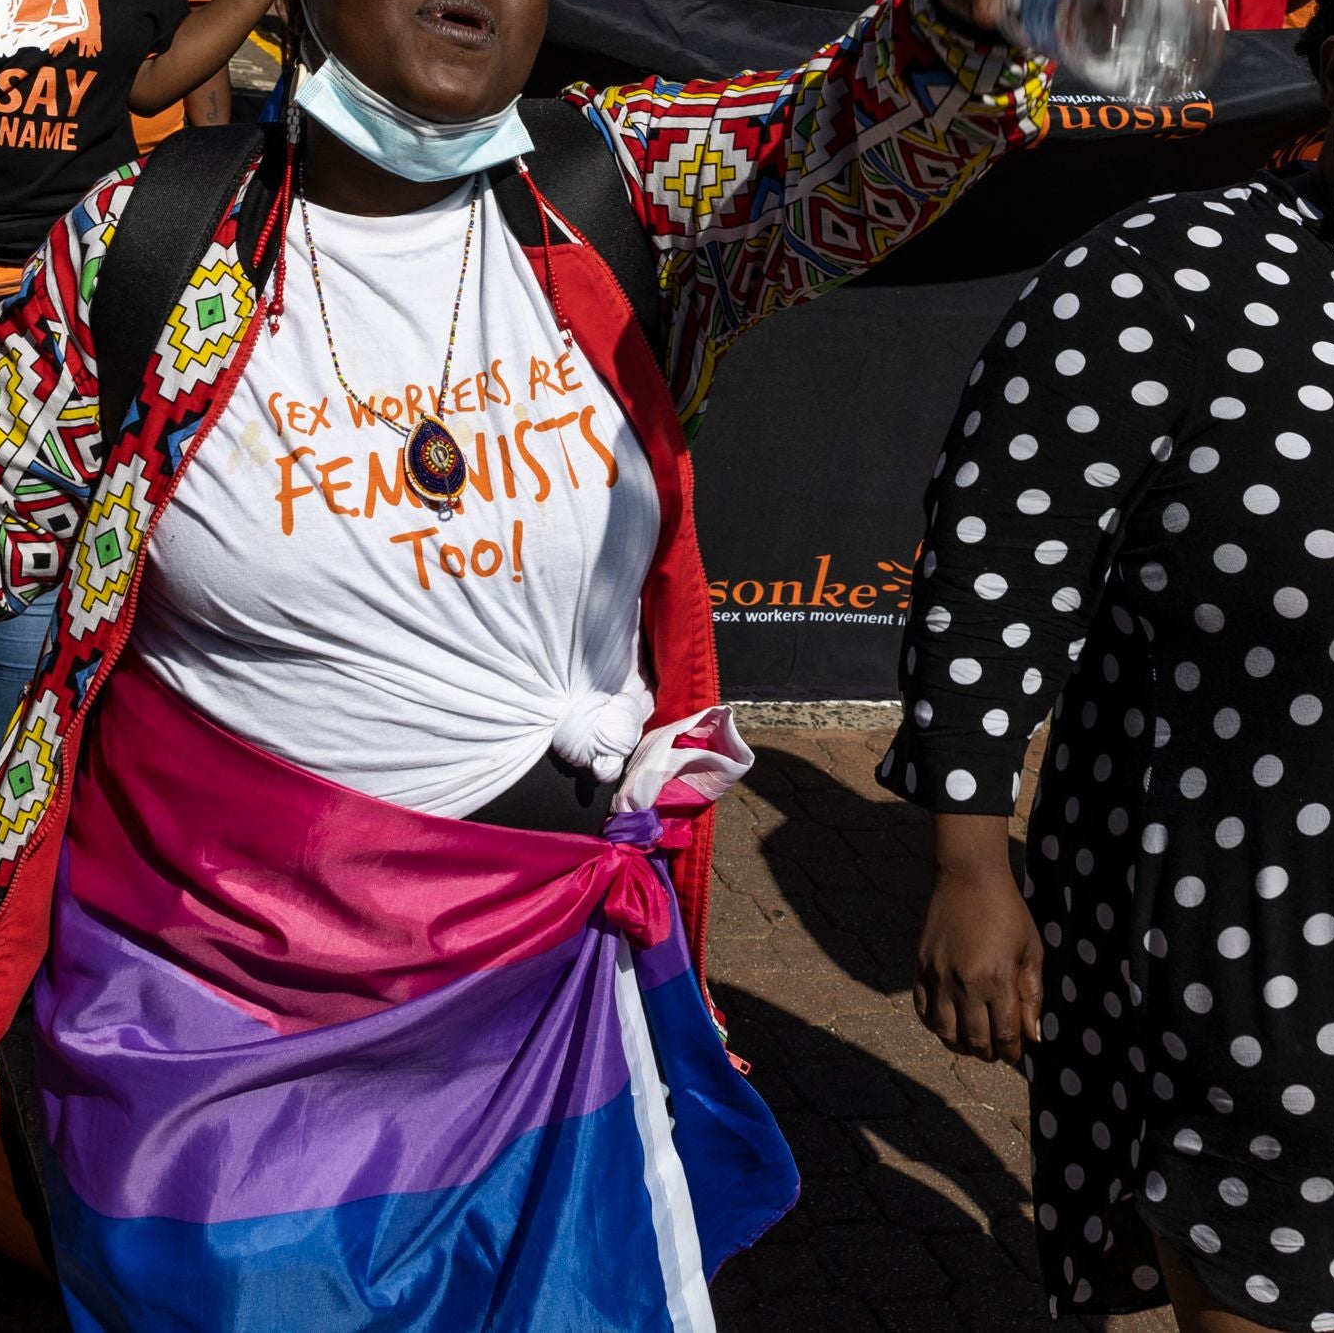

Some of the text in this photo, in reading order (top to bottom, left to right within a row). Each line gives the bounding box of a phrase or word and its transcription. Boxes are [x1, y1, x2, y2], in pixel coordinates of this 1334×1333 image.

[267, 352, 583, 437] SEX WORKERS ARE
[712, 611, 740, 622] sex
[745, 608, 806, 623] workers
[809, 610, 895, 626] movement
